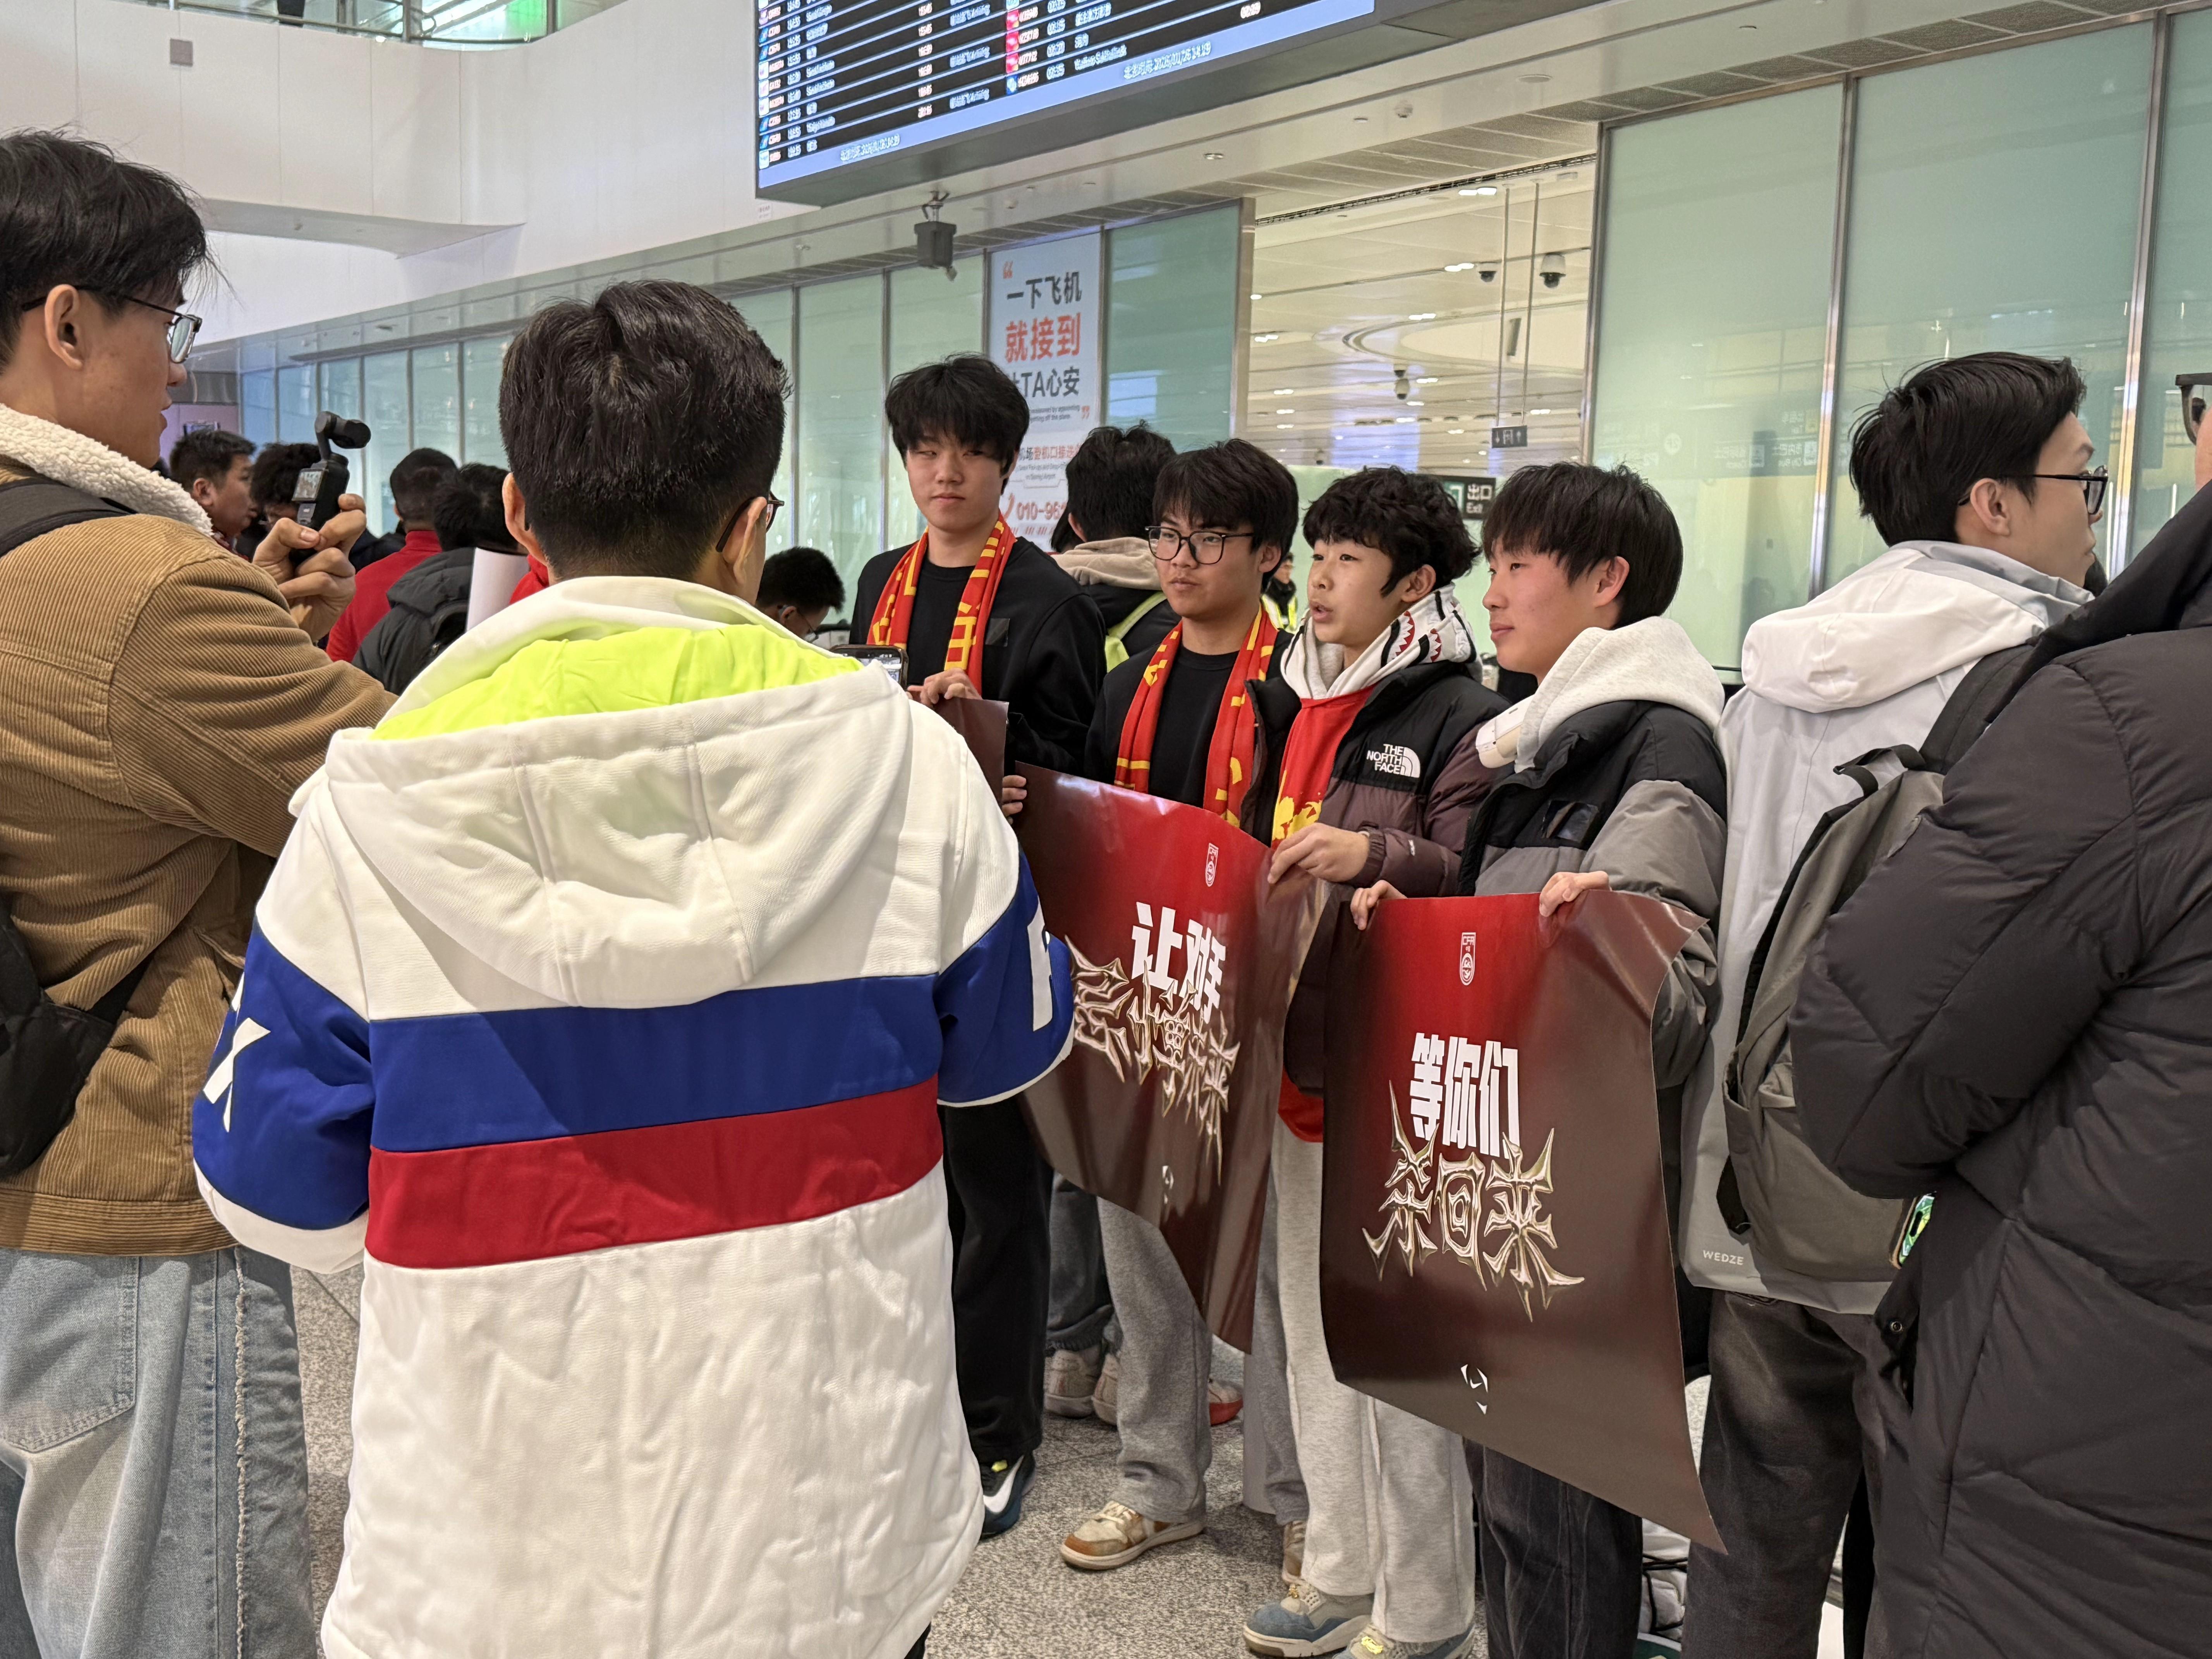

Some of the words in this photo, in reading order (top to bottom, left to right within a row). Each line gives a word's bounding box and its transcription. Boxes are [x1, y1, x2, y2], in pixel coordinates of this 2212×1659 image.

[1007, 271, 1082, 309] 一下飞机
[1005, 312, 1082, 363] 就接到
[1467, 483, 1493, 500] 出口
[1466, 501, 1484, 514] Exit
[1367, 750, 1402, 764] NORTH
[1383, 744, 1404, 756] THE
[1374, 761, 1400, 774] FACE
[1131, 901, 1226, 1024] 让对手
[1410, 1032, 1520, 1159] 等你们
[1362, 1080, 1585, 1322] 杀回来
[1703, 1250, 1744, 1265] WEDZE
